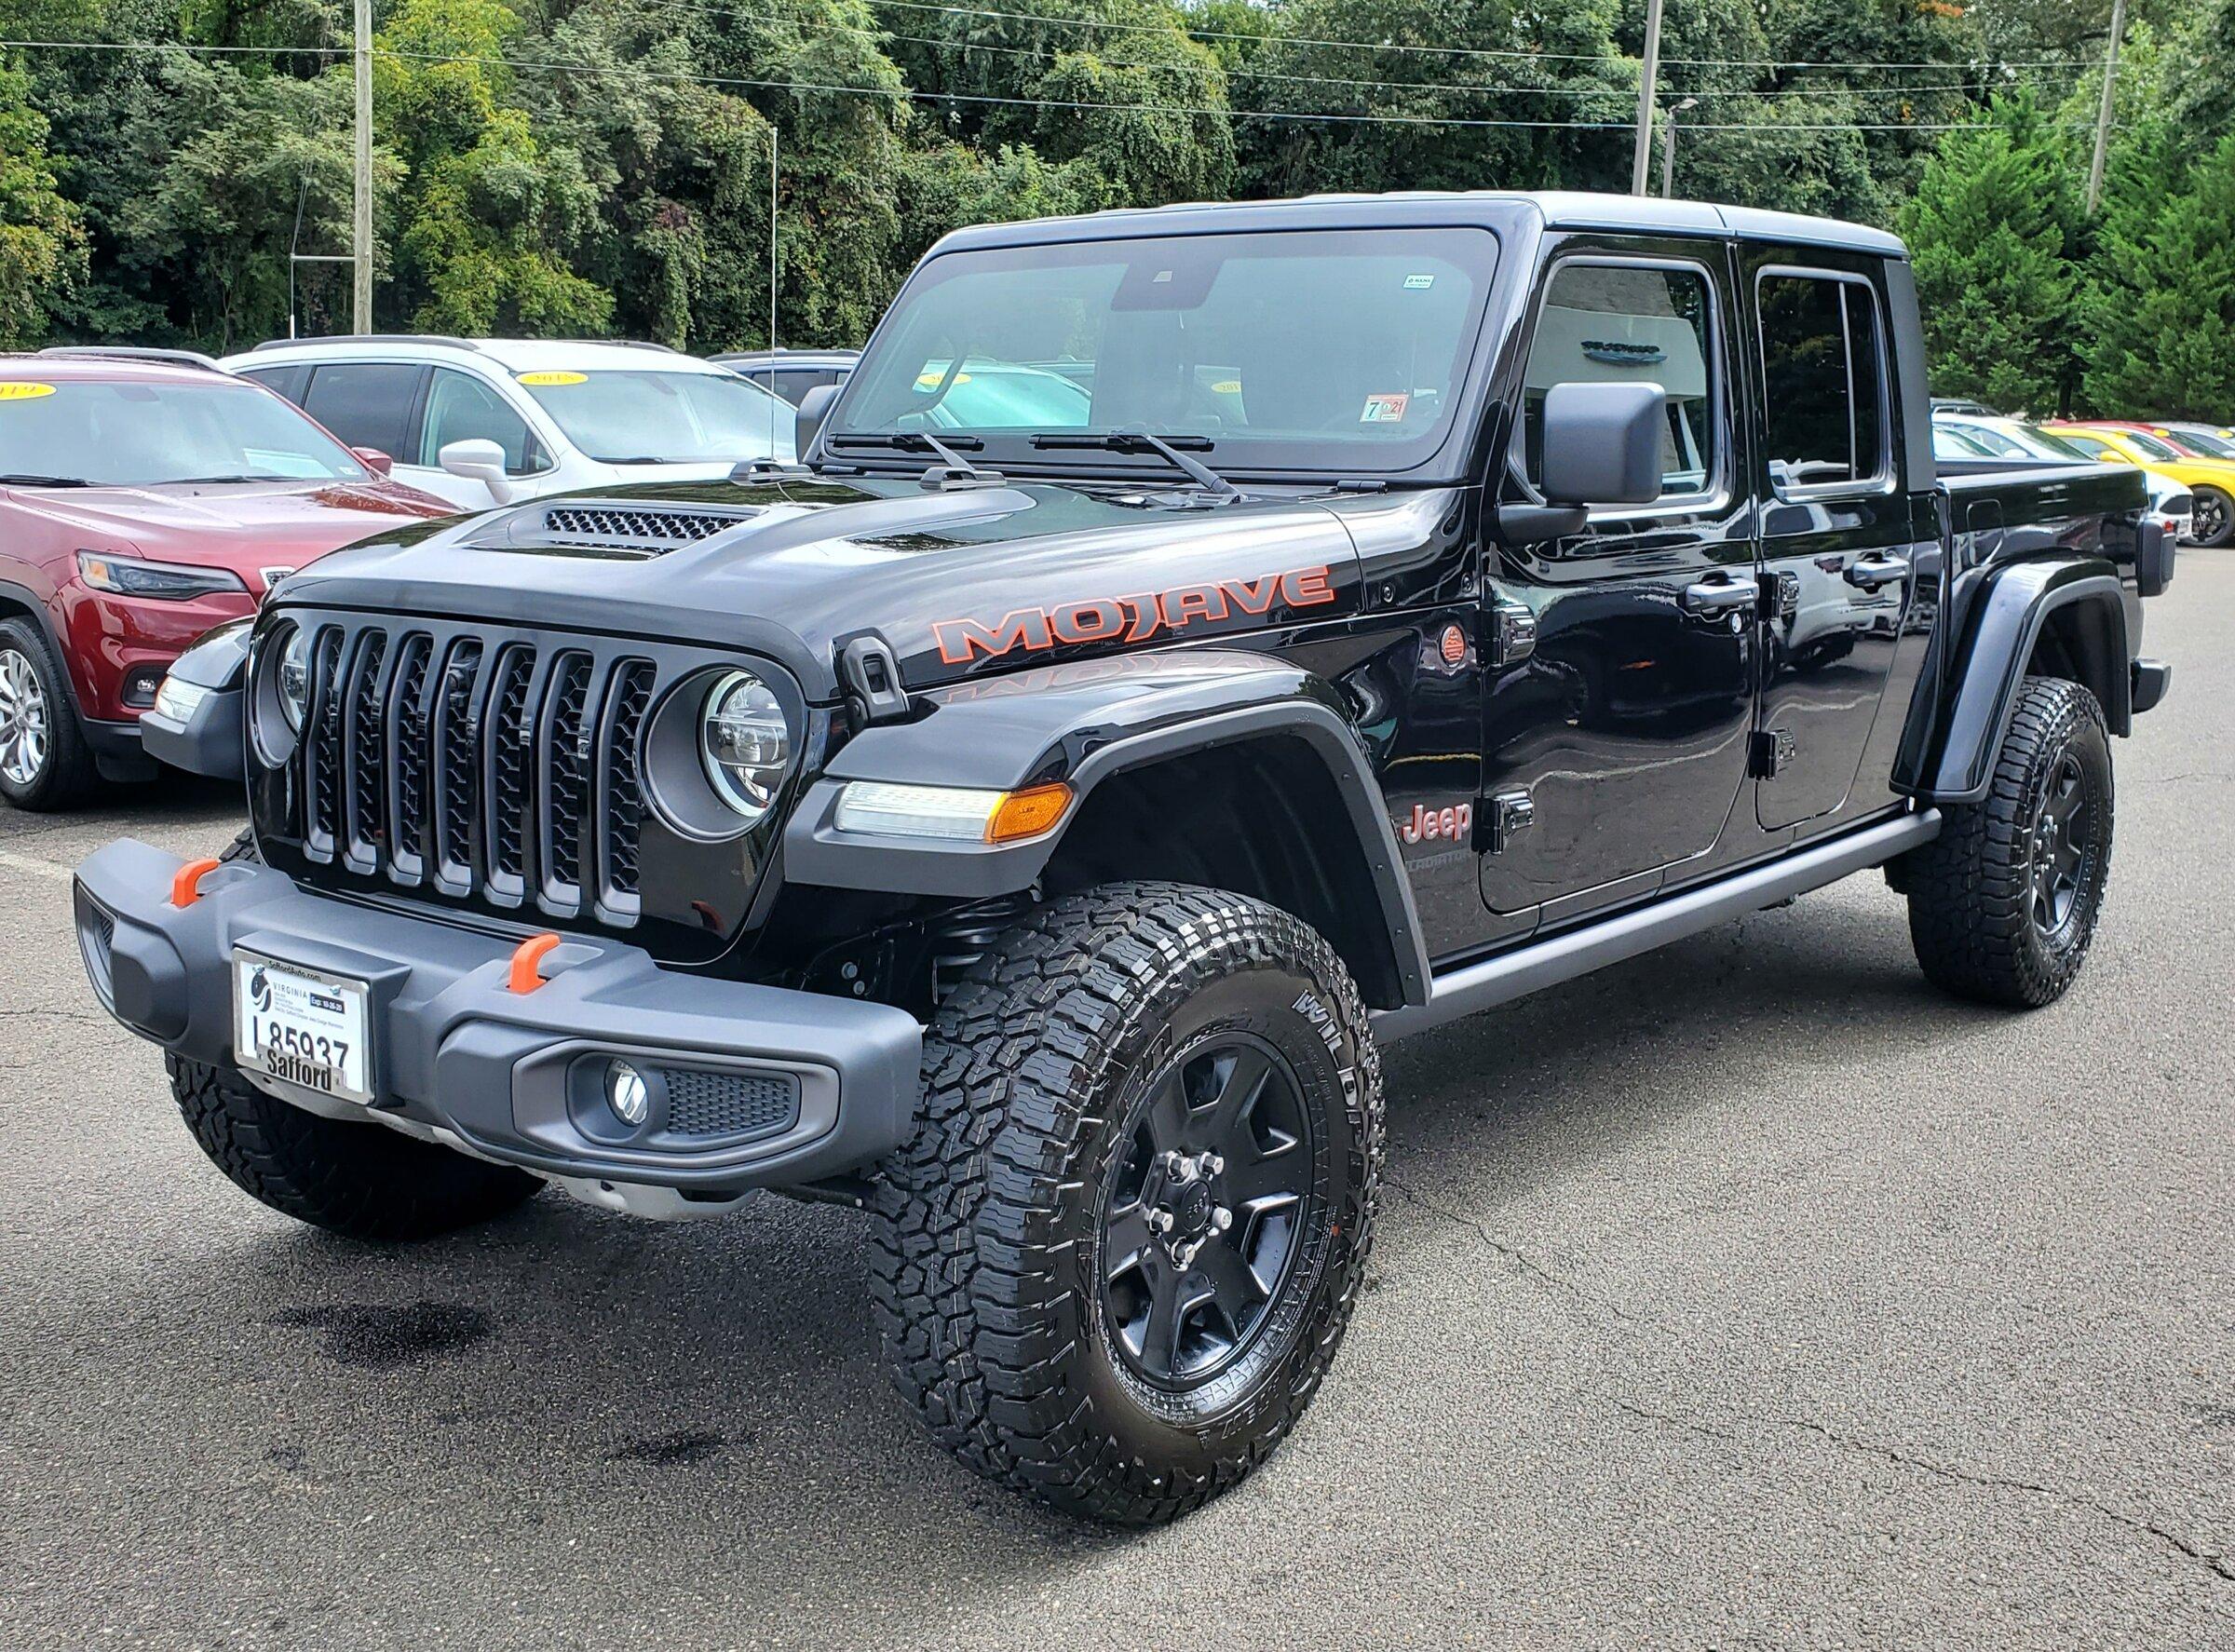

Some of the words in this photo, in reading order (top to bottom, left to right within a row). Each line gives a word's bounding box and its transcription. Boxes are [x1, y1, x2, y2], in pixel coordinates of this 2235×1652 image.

[1368, 402, 1380, 417] 7
[1390, 401, 1403, 413] 21
[932, 565, 1335, 664] MOJAVE
[1402, 804, 1472, 845] Jeep
[273, 982, 308, 999] VIRGINIA
[267, 1049, 332, 1092] Safford
